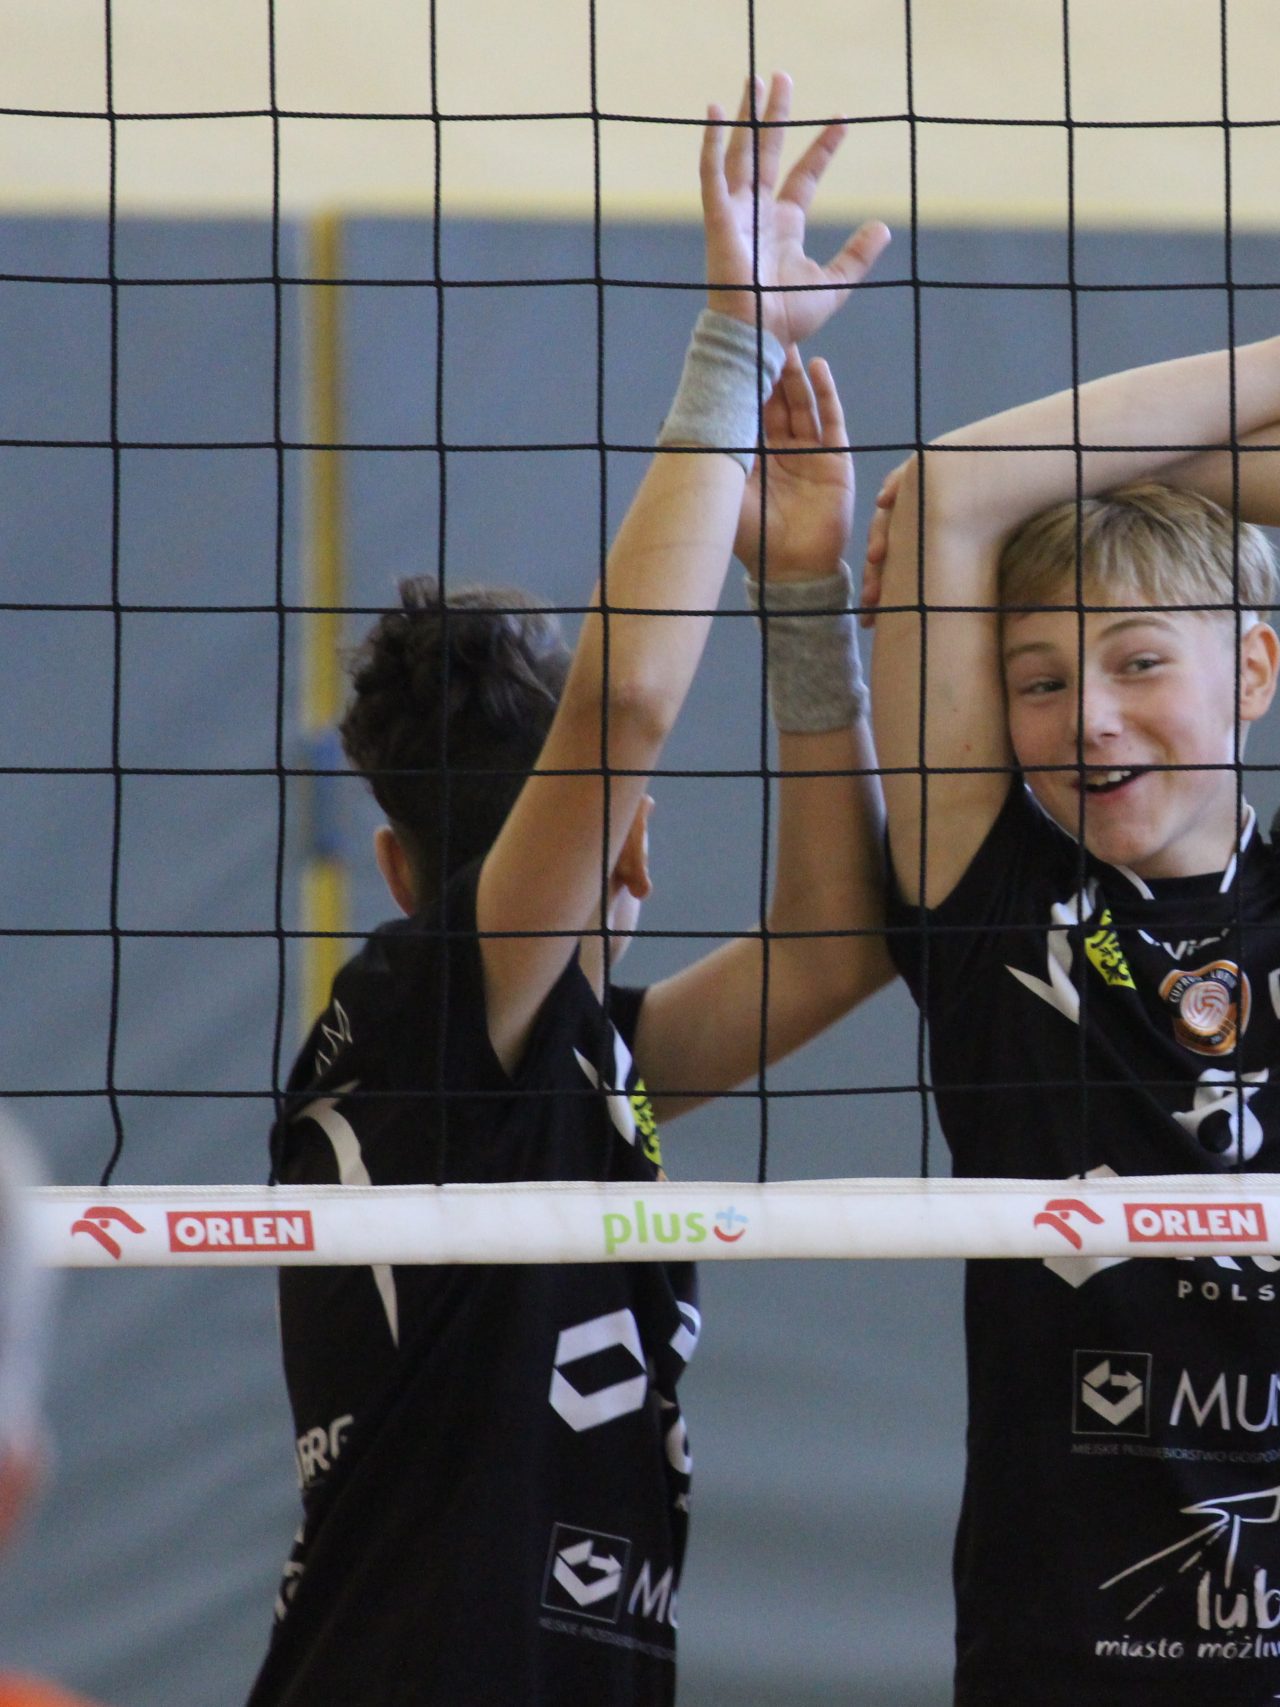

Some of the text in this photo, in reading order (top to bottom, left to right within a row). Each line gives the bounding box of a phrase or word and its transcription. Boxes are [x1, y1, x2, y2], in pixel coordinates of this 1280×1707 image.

[174, 1216, 307, 1247] ORLEN
[602, 1200, 708, 1254] plus
[1132, 1208, 1259, 1237] ORLEN
[1094, 1634, 1185, 1659] miasto
